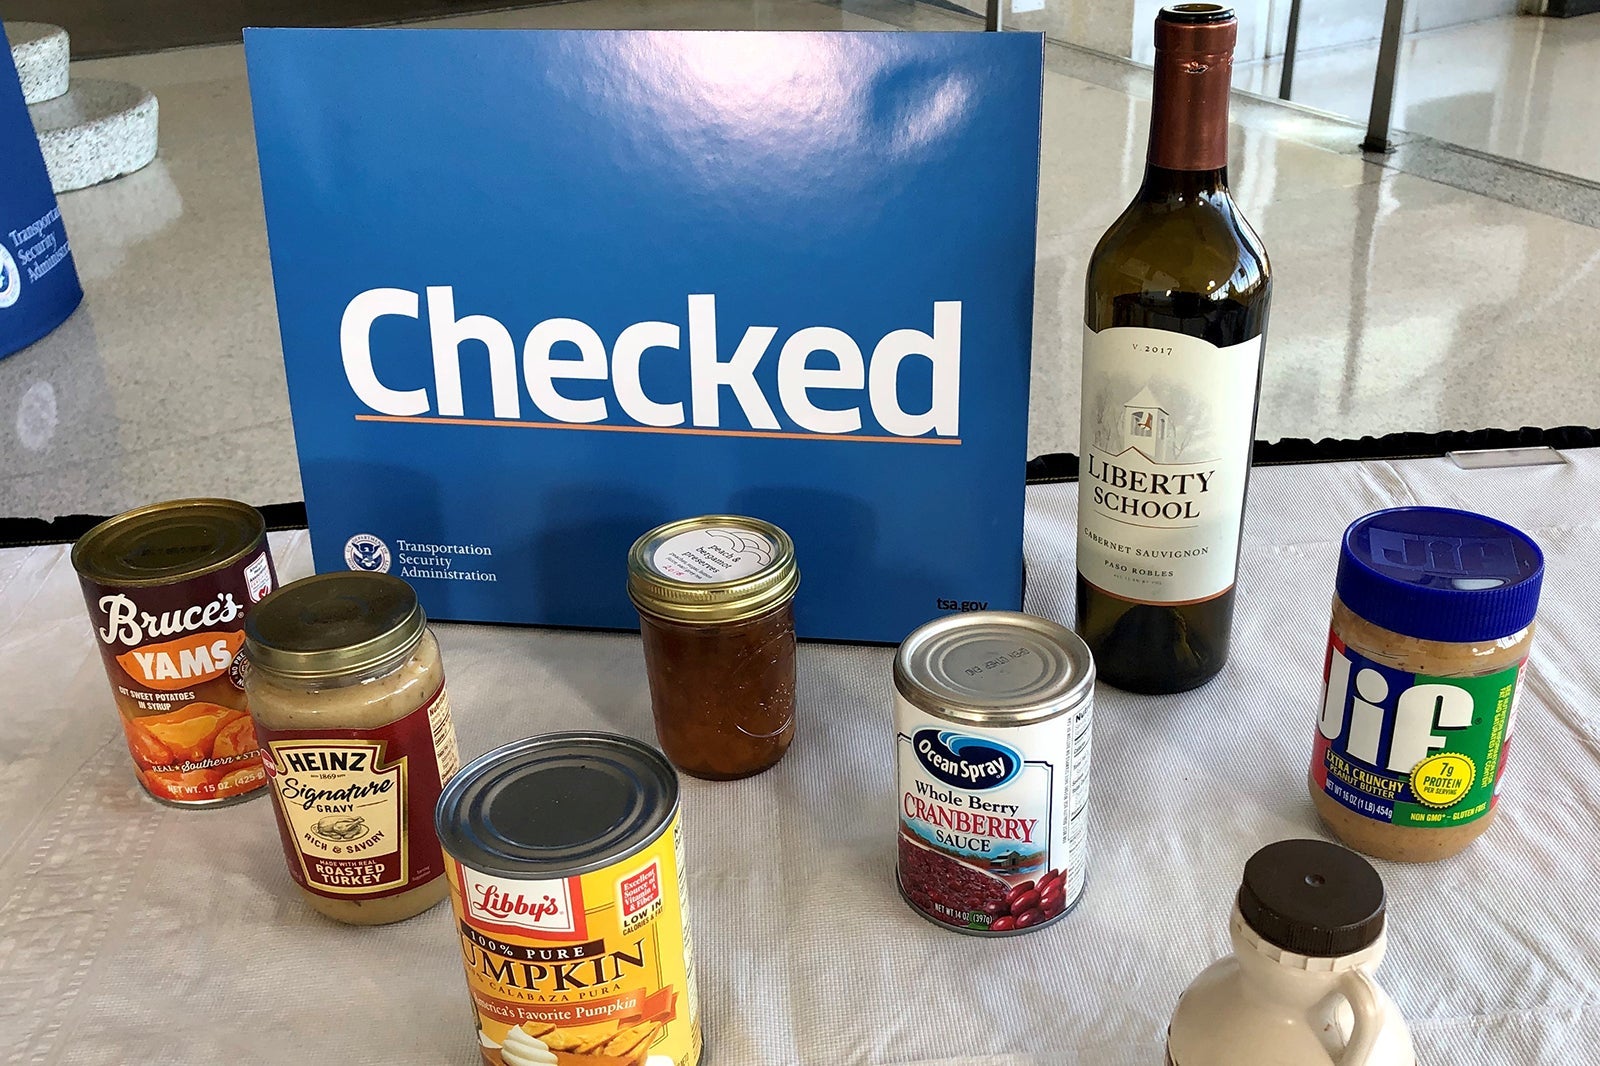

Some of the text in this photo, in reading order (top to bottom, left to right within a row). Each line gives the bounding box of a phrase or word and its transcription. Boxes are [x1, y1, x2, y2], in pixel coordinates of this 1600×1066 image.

[17, 231, 57, 266] Security
[339, 285, 962, 436] Checked
[1145, 345, 1173, 356] 2017
[1088, 453, 1215, 495] LIBERTY
[1093, 486, 1200, 520] SCHOOL
[396, 539, 492, 556] Transportation
[708, 545, 734, 559] peach
[1084, 527, 1209, 559] CABERNET SAUVIGNON
[399, 553, 452, 569] Security
[681, 551, 720, 573] preserves
[696, 546, 732, 569] bergamot
[1104, 559, 1174, 577] PASO ROBLES
[400, 566, 497, 582] Administration
[936, 598, 989, 612] tsa.gov
[99, 593, 243, 646] Bruce's
[133, 640, 233, 680] YAMS
[130, 689, 153, 701] SWEET
[155, 691, 196, 701] POTATOES
[138, 701, 172, 711] IN SYRUP
[1318, 644, 1475, 774] Jif
[152, 765, 175, 773] REAL
[181, 756, 234, 773] Southern
[285, 752, 368, 772] HEINZ
[918, 738, 1006, 783] Ocean Spray
[1326, 749, 1404, 793] EXTRA CRUNCHY
[1440, 763, 1454, 777] 7g
[167, 785, 183, 793] NET
[185, 786, 202, 794] WT.
[203, 785, 215, 793] 15
[218, 781, 233, 790] OZ.
[235, 773, 255, 787] (425
[1329, 764, 1395, 799] PEANUT BUTTER
[1423, 776, 1462, 789] PROTEIN
[1433, 787, 1457, 796] SERVING
[282, 777, 396, 811] Signature
[914, 779, 1019, 818] Whole Berry
[1326, 778, 1334, 791] NET
[1334, 784, 1342, 796] WT
[1349, 794, 1357, 806] OZ
[1357, 797, 1364, 809] (1
[1364, 801, 1376, 814] LB)
[1376, 805, 1393, 819] 454g
[316, 804, 355, 814] GRAVY
[903, 791, 1037, 844] CRANBERRY
[1410, 813, 1425, 821] NON
[1452, 808, 1475, 820] GLUTEN
[304, 830, 385, 854] RICH & SAVORY
[936, 829, 991, 853] SAUCE
[315, 863, 385, 875] ROASTED
[321, 873, 383, 885] TURKEY
[624, 869, 655, 891] Excellent
[624, 875, 656, 899] Source of
[625, 883, 656, 905] Vitamin A
[473, 882, 559, 922] Libby's
[623, 898, 662, 927] LOW IN
[629, 893, 654, 912] & Fiber
[934, 902, 993, 925] NET WT 14 OZ (397g)
[623, 917, 649, 936] CALORIES
[655, 906, 663, 918] FAT
[469, 930, 585, 960] 100% PURE
[459, 931, 646, 992] UMPKIN
[489, 981, 621, 1003] CALABAZA PURA
[473, 990, 637, 1022] America's Favorite Pumpkin
